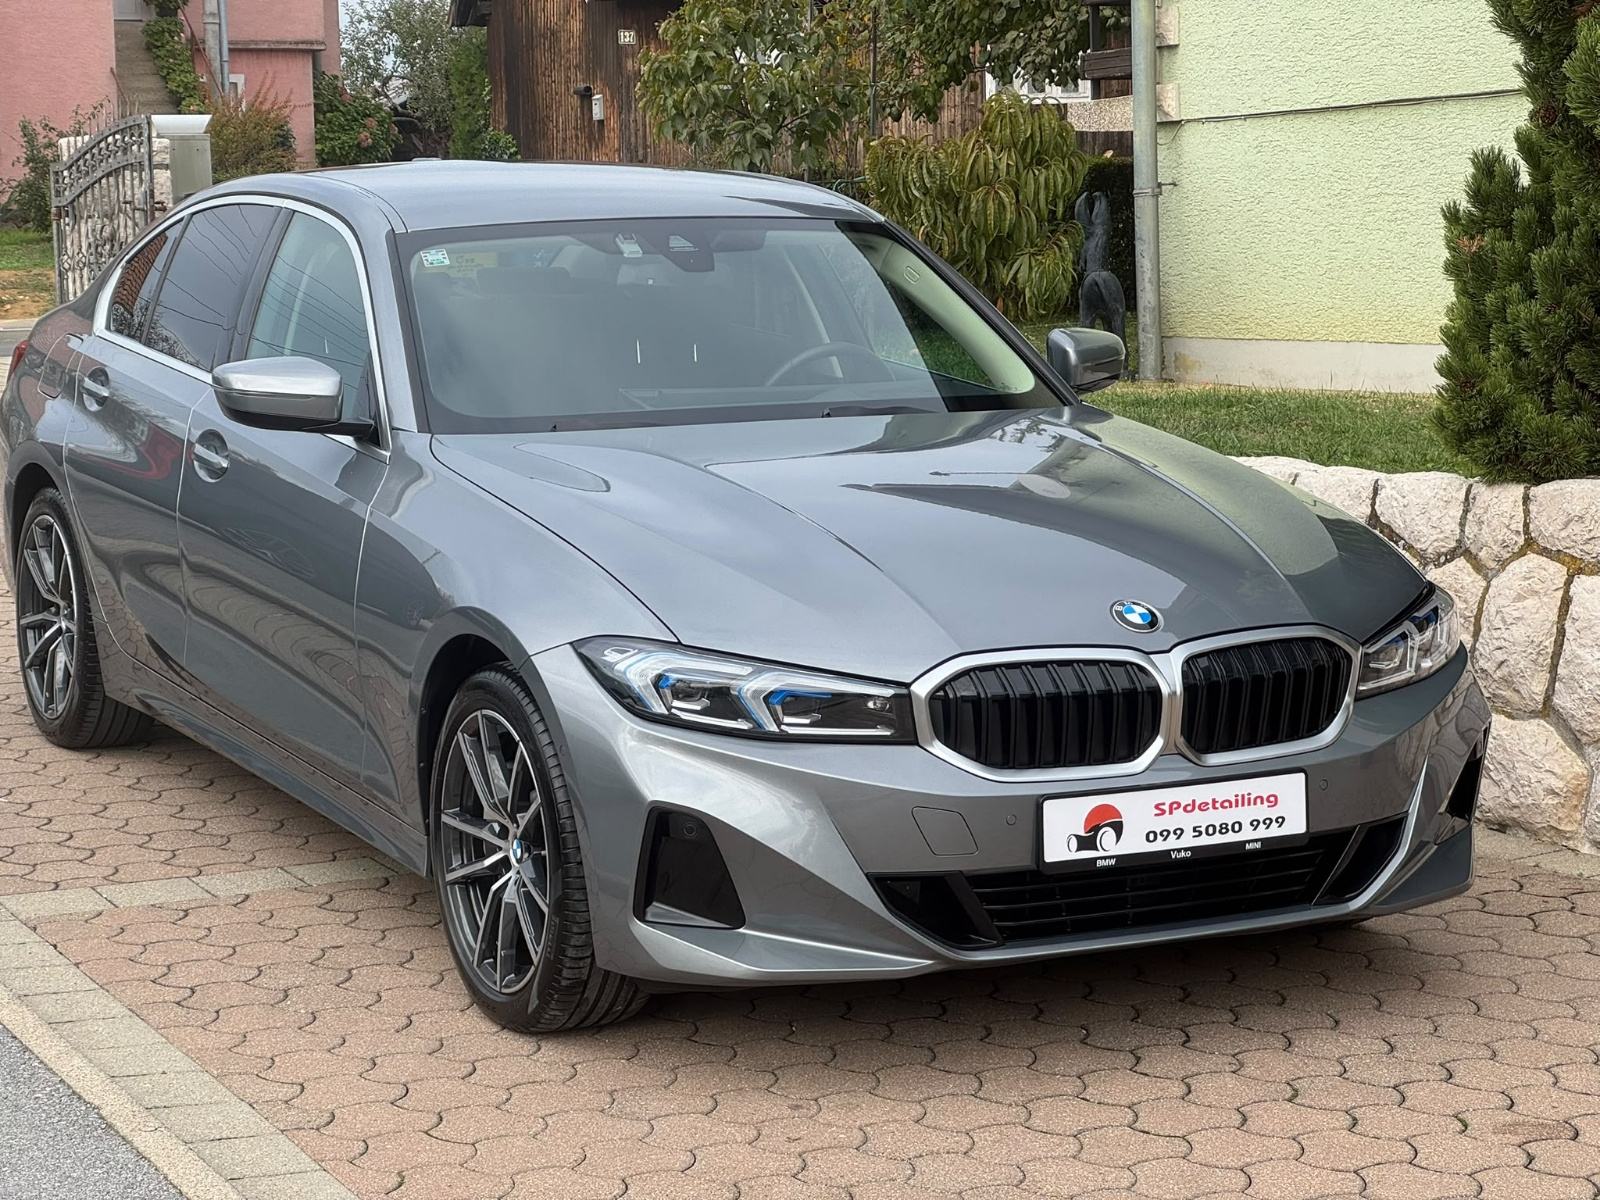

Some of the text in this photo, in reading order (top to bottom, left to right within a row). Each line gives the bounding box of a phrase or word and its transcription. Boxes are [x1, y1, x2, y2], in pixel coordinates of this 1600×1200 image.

[620, 31, 634, 42] 137
[1153, 792, 1279, 817] SPdetailing
[1145, 815, 1286, 843] 099 5080 999
[1096, 841, 1262, 867] BMW Vuko MINI
